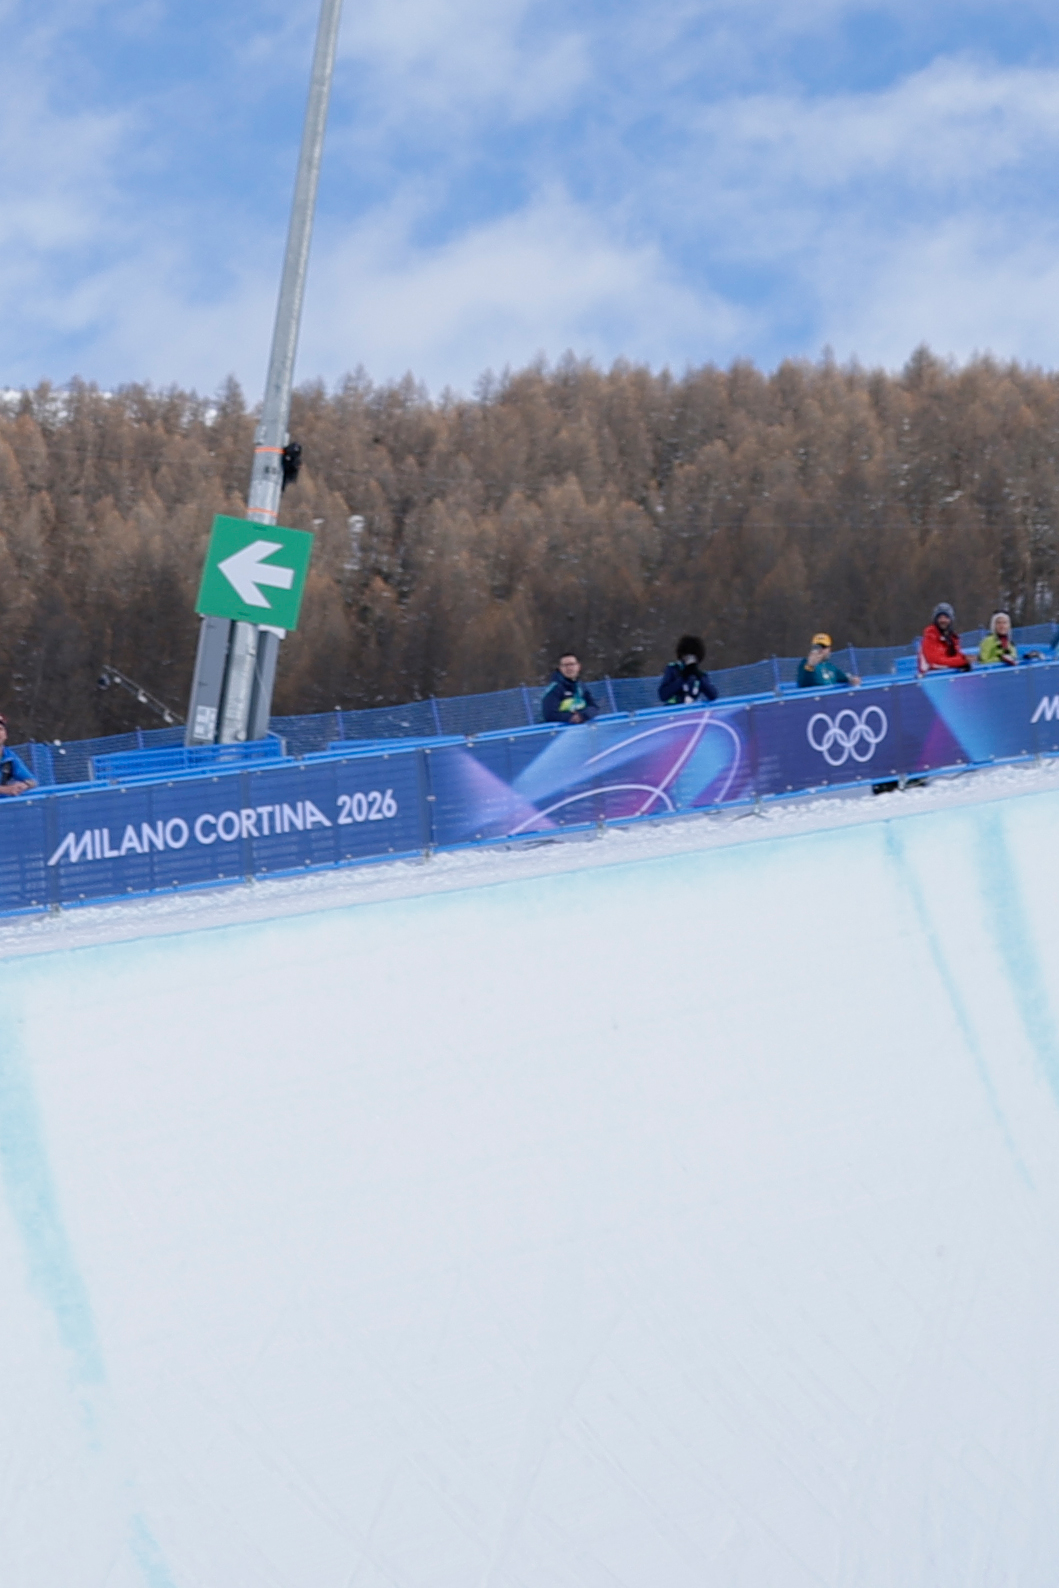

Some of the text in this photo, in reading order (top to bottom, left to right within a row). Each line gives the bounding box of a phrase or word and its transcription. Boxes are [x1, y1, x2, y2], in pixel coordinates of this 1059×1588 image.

[47, 788, 398, 866] MILANO CORTINA 2026
